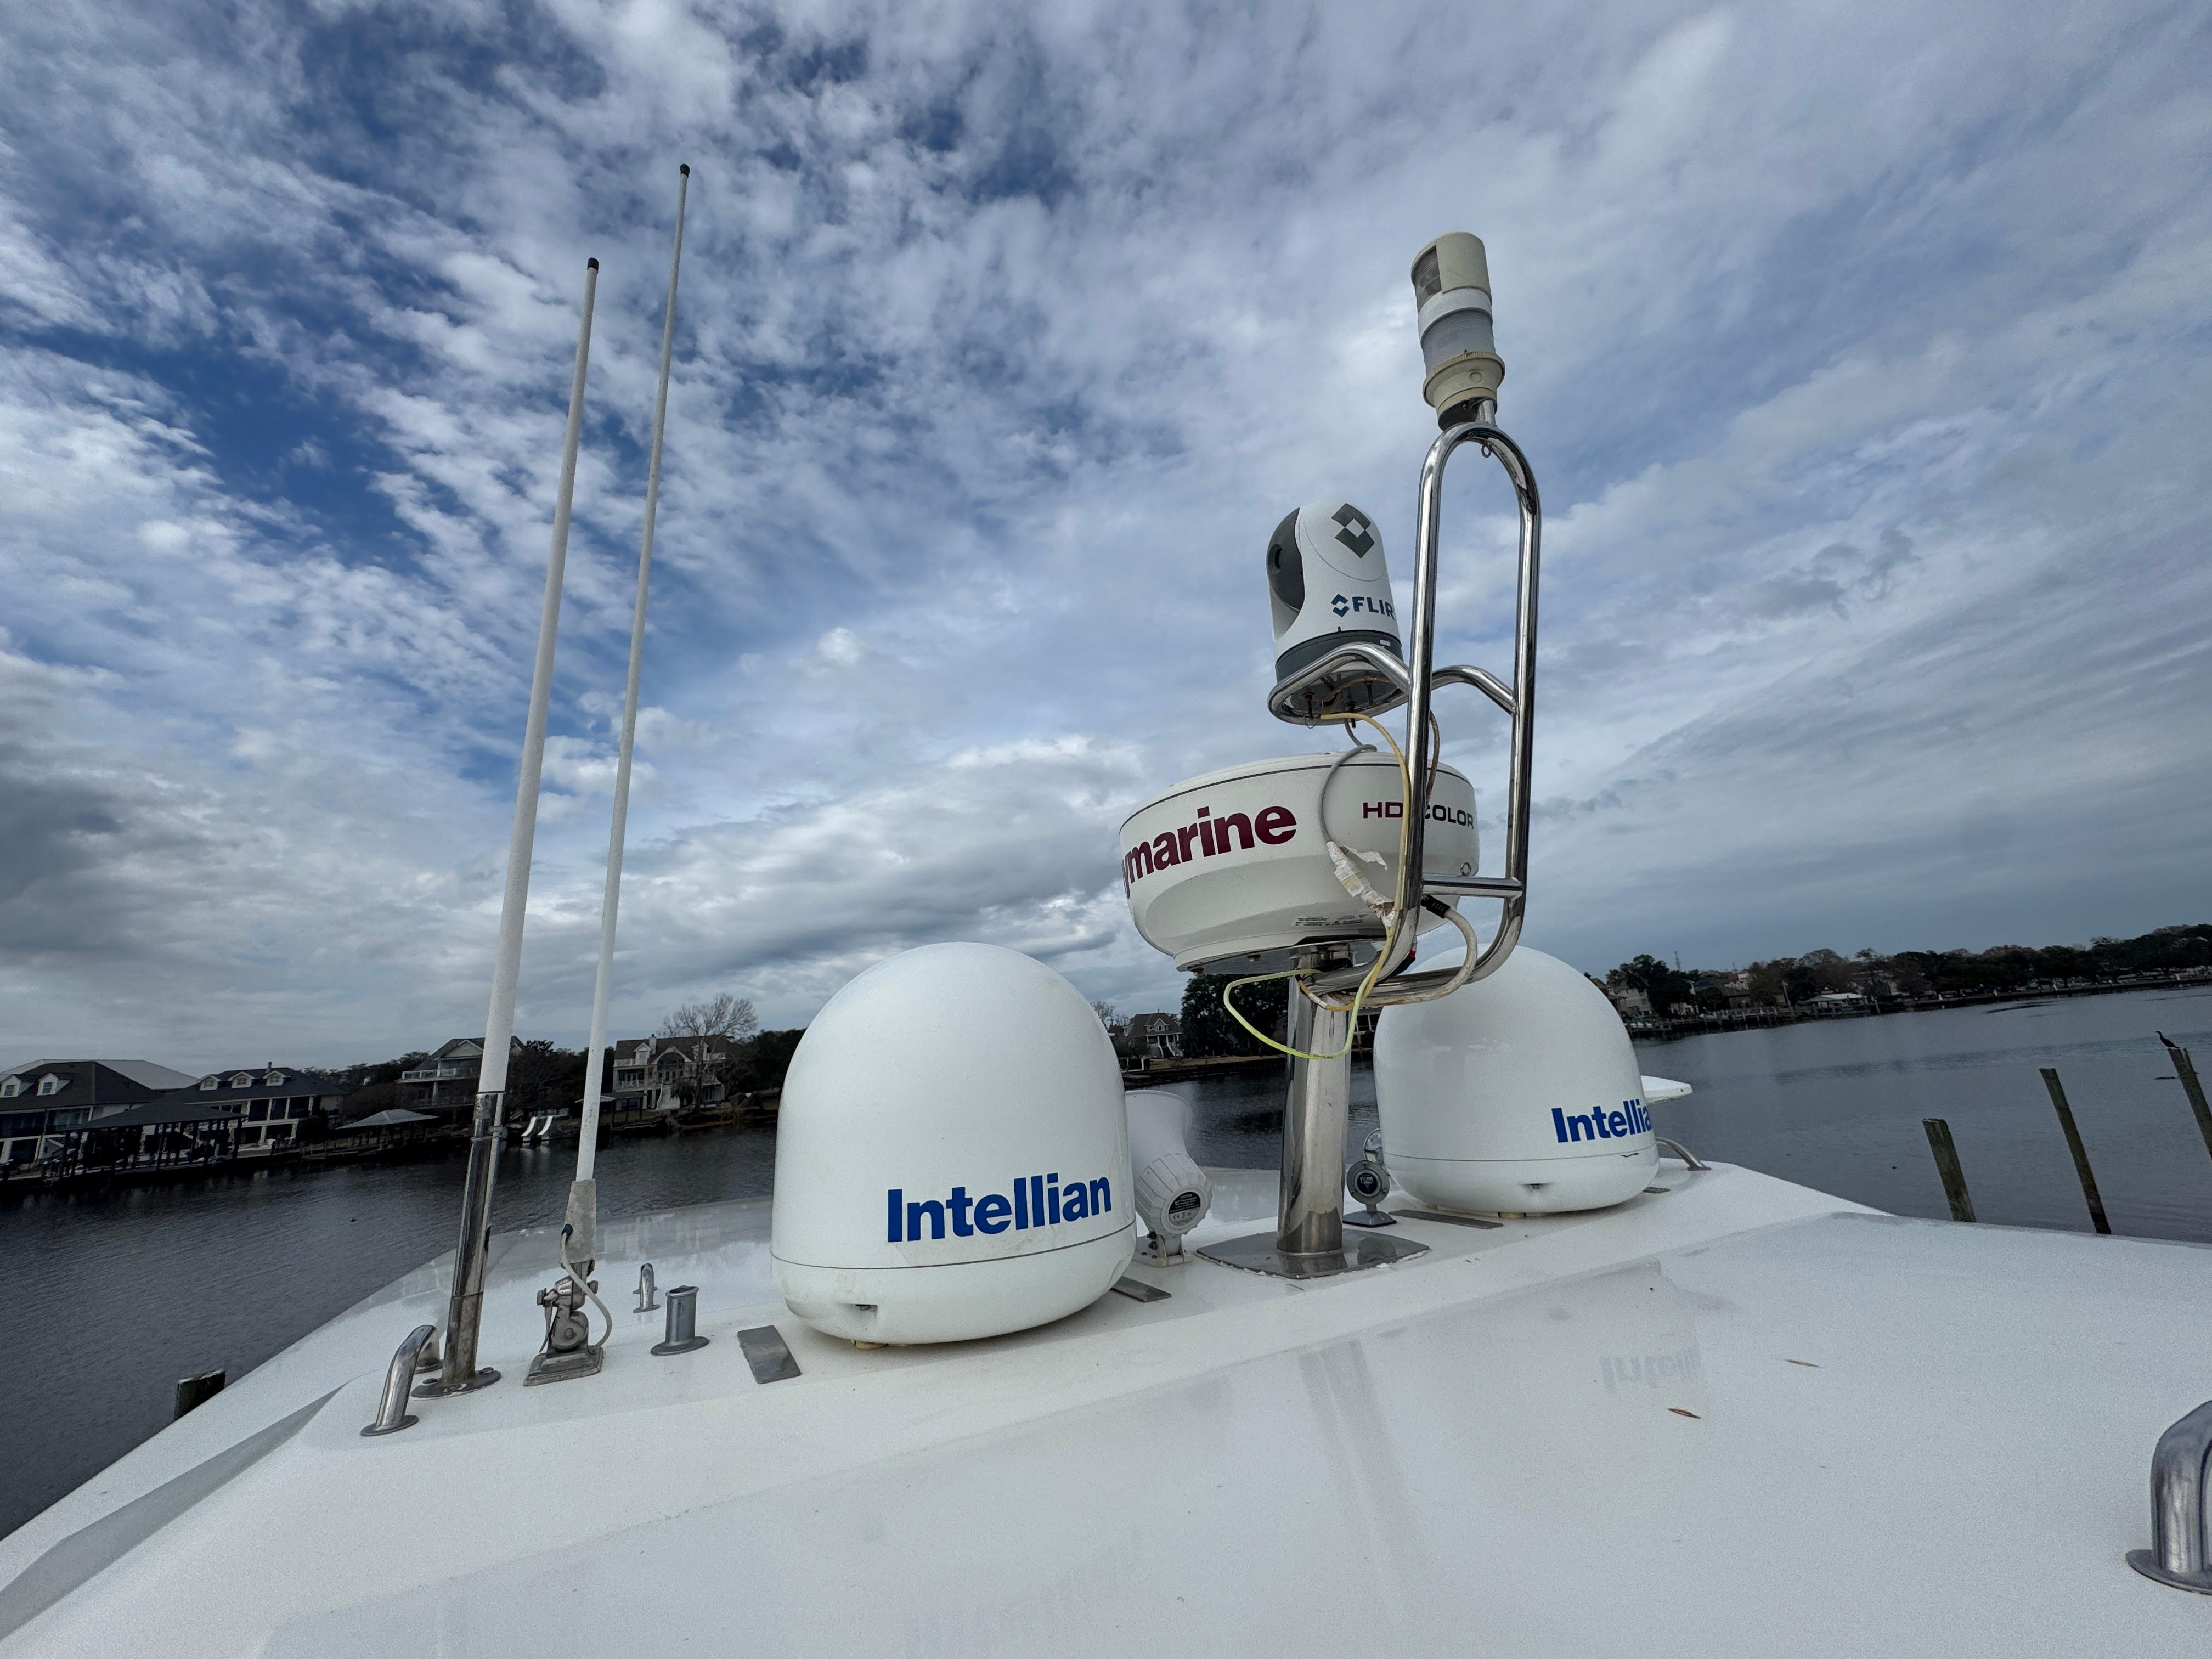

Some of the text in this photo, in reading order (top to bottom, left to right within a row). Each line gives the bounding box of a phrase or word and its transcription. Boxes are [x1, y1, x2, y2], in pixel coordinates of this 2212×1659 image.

[1352, 596, 1396, 621] FLIR
[1362, 802, 1404, 819] HD
[887, 1172, 1112, 1243] Intellian
